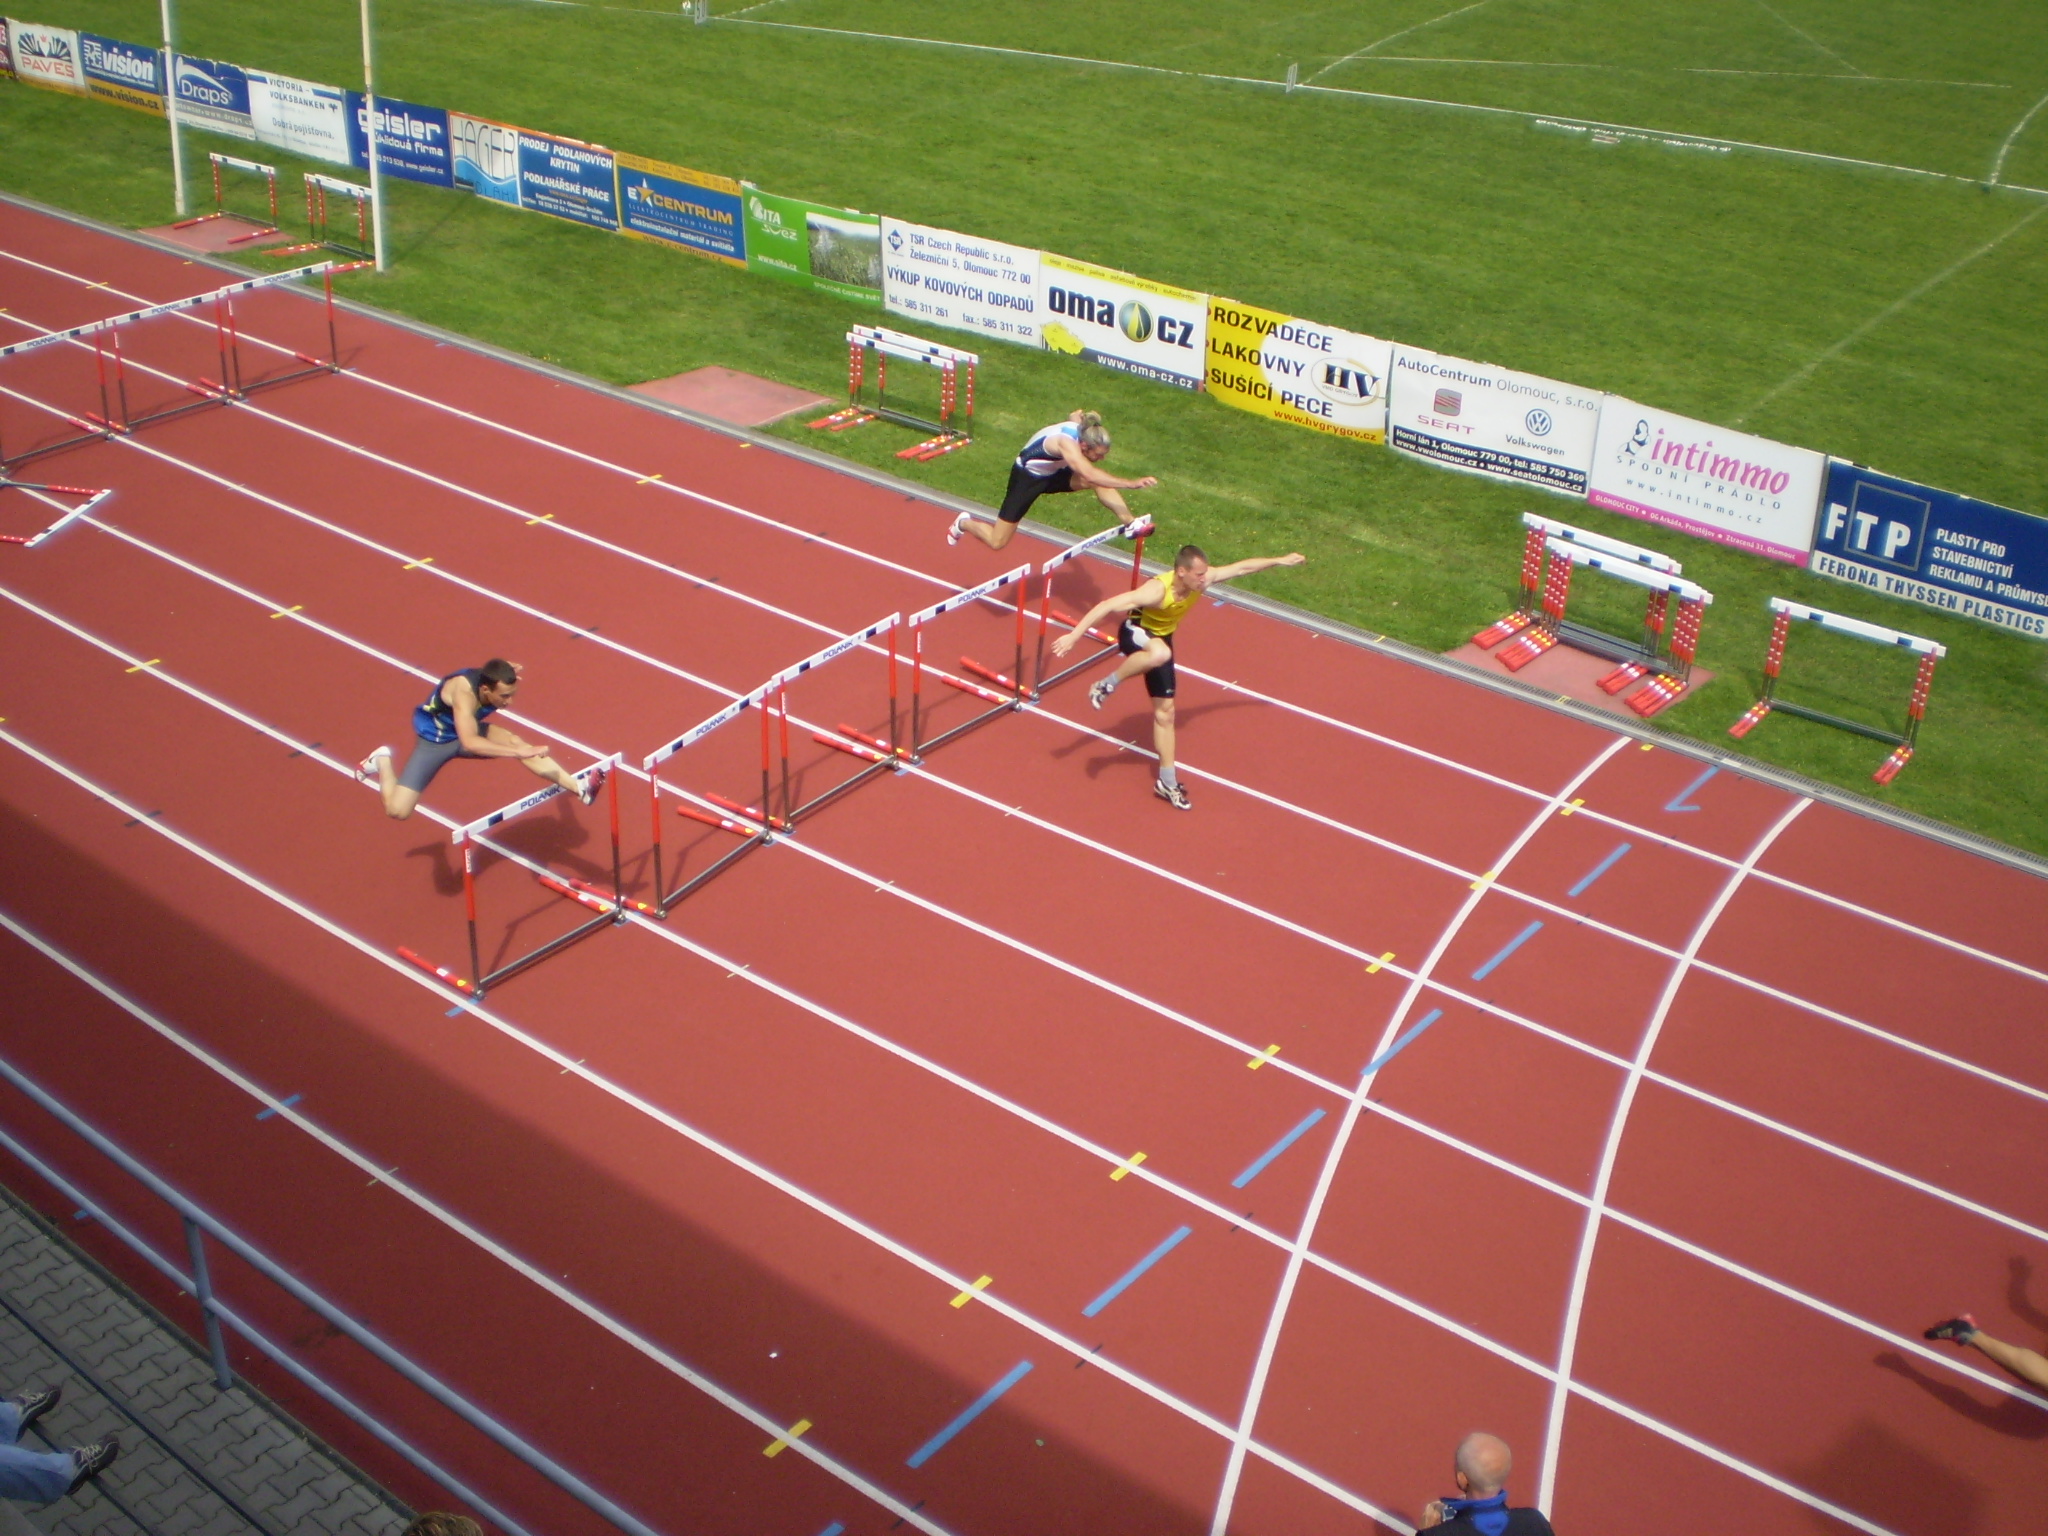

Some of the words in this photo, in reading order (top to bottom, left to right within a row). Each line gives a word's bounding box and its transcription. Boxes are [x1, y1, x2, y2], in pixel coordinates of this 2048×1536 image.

[21, 56, 75, 78] PAVES
[103, 47, 154, 82] vision
[90, 83, 159, 110] www.vision.cz
[181, 79, 229, 105] Draps
[269, 78, 303, 93] VICTORIA
[270, 91, 326, 110] VOLKSBANKEN
[519, 136, 549, 152] PRODEJ
[553, 145, 612, 168] PODLAHOVÝCH
[550, 157, 580, 173] KRYTIN
[524, 171, 581, 194] PODLAHÁŘSKÉ
[582, 186, 610, 202] PRÁCE
[910, 233, 925, 245] TSR
[928, 237, 952, 251] Czech
[955, 243, 989, 259] Republic
[993, 253, 1014, 265] s.r.o.
[910, 246, 949, 266] Železniční
[952, 258, 960, 270] 5,
[964, 261, 998, 278] Olomouc
[1002, 269, 1016, 281] 772
[1020, 273, 1031, 284] 00
[887, 264, 920, 286] VÝKUP
[924, 276, 983, 303] KOVOVÝCH
[988, 294, 1034, 313] ODPADŮ
[904, 298, 917, 311] 585
[920, 302, 932, 314] 311
[936, 306, 948, 318] 261
[982, 317, 997, 329] 585
[1000, 321, 1014, 333] 311
[1017, 326, 1033, 337] 322
[1048, 285, 1115, 328] oma
[1097, 354, 1193, 389] www.oma-cz.cz
[1212, 337, 1306, 377] LAKOVNY
[1211, 367, 1273, 402] SUŠÍCÍ
[1281, 390, 1333, 418] PECE
[1323, 363, 1381, 399] HV
[1398, 357, 1492, 388] AutoCentrum
[1497, 379, 1560, 405] Olomouc,
[1565, 395, 1598, 412] s.r.o.
[1274, 410, 1377, 441] www.hvgrygov.cz
[1417, 415, 1475, 435] SEAT
[1396, 428, 1417, 441] Horní
[1418, 435, 1430, 445] lán
[1432, 440, 1440, 450] 1,
[1441, 442, 1478, 458] Olomouc
[1480, 451, 1497, 461] 779
[1498, 455, 1513, 466] 00,
[1514, 459, 1528, 469] tel:
[1530, 462, 1547, 472] 585
[1549, 467, 1566, 477] 750
[1567, 471, 1585, 482] 369
[1506, 434, 1565, 456] Volkswagen
[1651, 428, 1790, 495] intimmo
[1396, 439, 1478, 467] www.vwolomouc.cz
[1487, 463, 1583, 492] www.seatolomouc.cz
[1617, 455, 1688, 483] SPODNÍ
[1705, 480, 1781, 510] PRÁDLO
[1626, 478, 1762, 524] www.intimmo.cz
[1595, 494, 1624, 508] OLOMOUC
[1626, 504, 1640, 514] CITY
[1650, 512, 1659, 520] OG
[1686, 523, 1715, 537] Prostějov
[1726, 534, 1754, 548] Ztracená
[1767, 546, 1796, 560] Olomouc
[1825, 502, 1911, 559] FTP
[1936, 528, 1980, 550] PLASTY
[1982, 541, 2006, 558] PRO
[1929, 564, 1983, 589] REKLAMU
[1985, 579, 1994, 593] A
[1932, 546, 2014, 579] STAVEBNICTVÍ
[1819, 556, 1879, 588] FERONA
[1886, 576, 1958, 610] THYSSEN
[1963, 599, 2045, 635] PLASTICS
[520, 784, 561, 810] POLANIK
